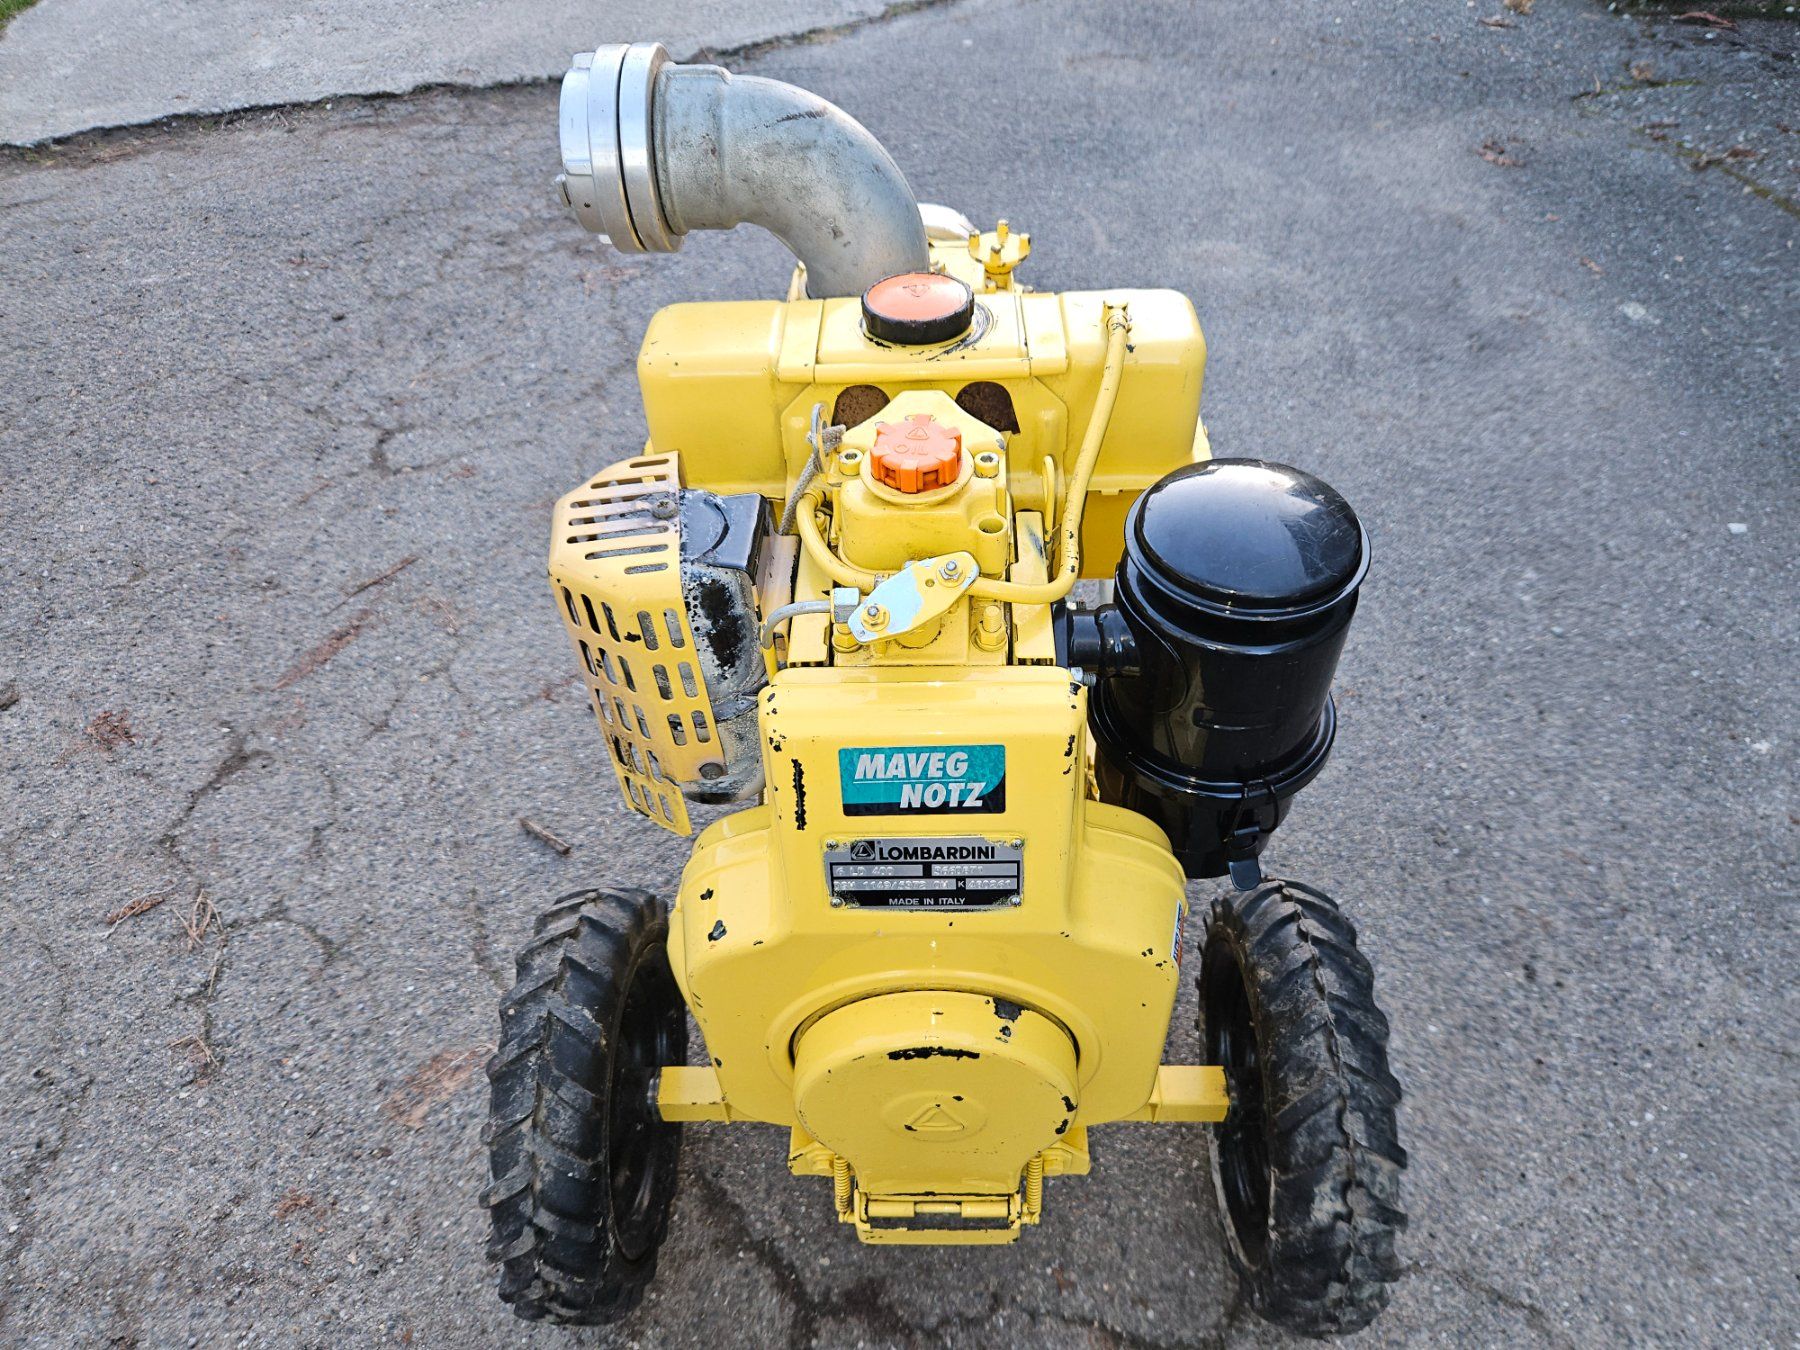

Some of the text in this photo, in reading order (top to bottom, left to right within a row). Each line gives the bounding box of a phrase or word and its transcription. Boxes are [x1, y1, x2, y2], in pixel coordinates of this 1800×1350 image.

[893, 441, 929, 456] OIL
[855, 751, 969, 779] MAVEG
[900, 781, 986, 809] NOTZ
[879, 846, 995, 860] LOMBARDINI
[888, 897, 966, 906] MADE IN ITALY
